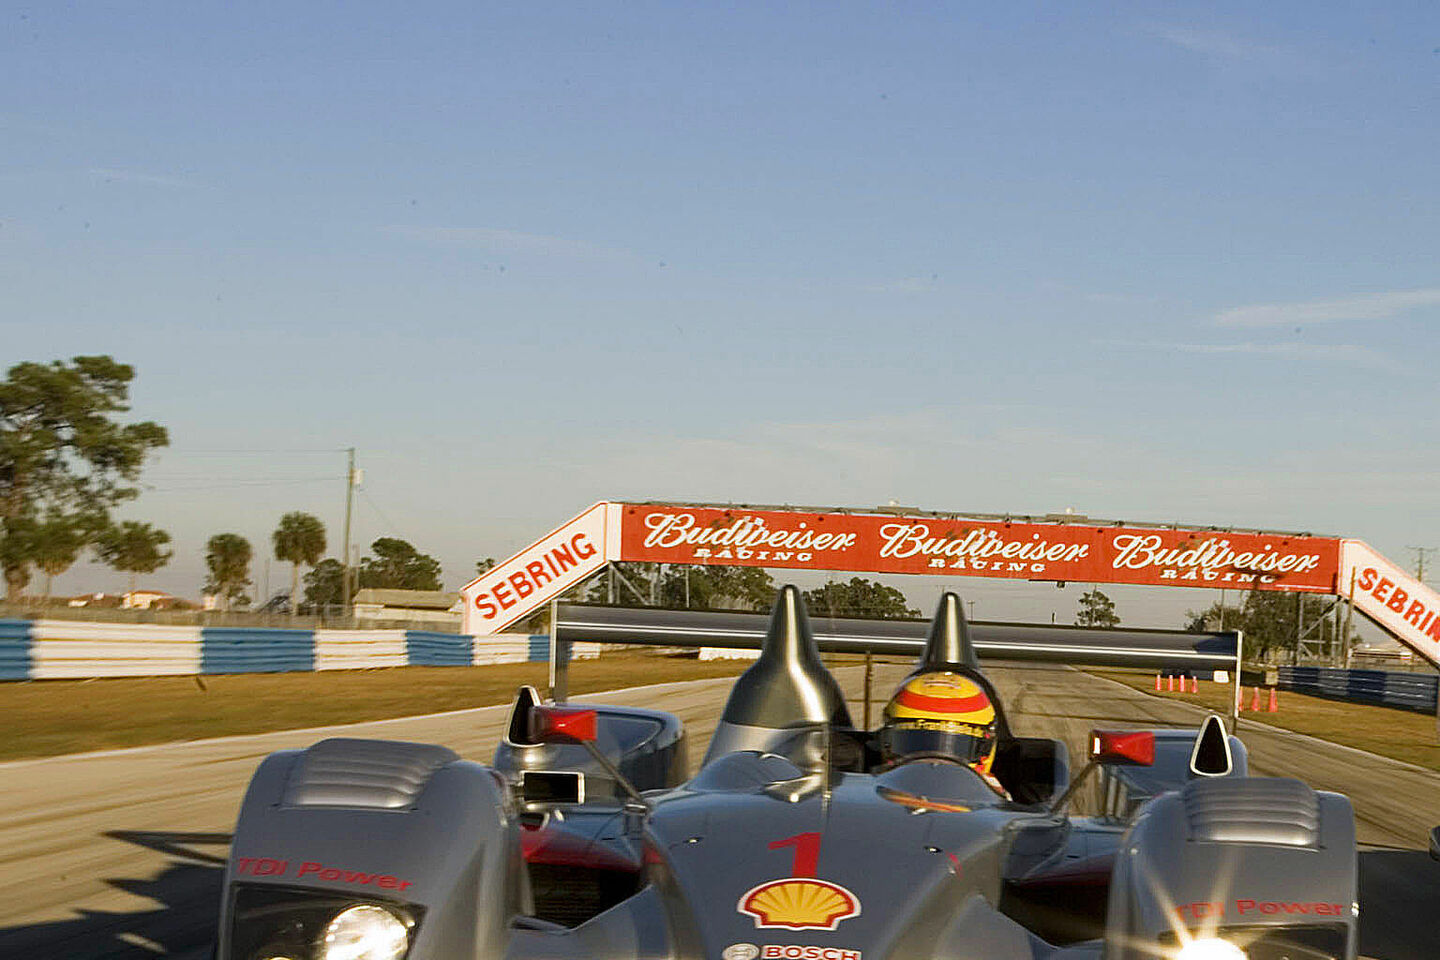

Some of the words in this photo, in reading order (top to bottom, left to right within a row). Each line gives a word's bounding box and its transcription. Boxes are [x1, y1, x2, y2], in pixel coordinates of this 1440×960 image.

[644, 511, 857, 552] Budweiser
[879, 523, 1089, 562] Budweiser
[693, 547, 814, 562] RACING
[928, 557, 1046, 573] RACING
[1113, 534, 1320, 573] Budweiser
[474, 531, 598, 620] SEBRING
[1160, 568, 1276, 584] RACING
[768, 832, 824, 878] 1
[238, 857, 289, 877] TDI
[297, 861, 413, 892] Power
[1235, 899, 1343, 916] Power
